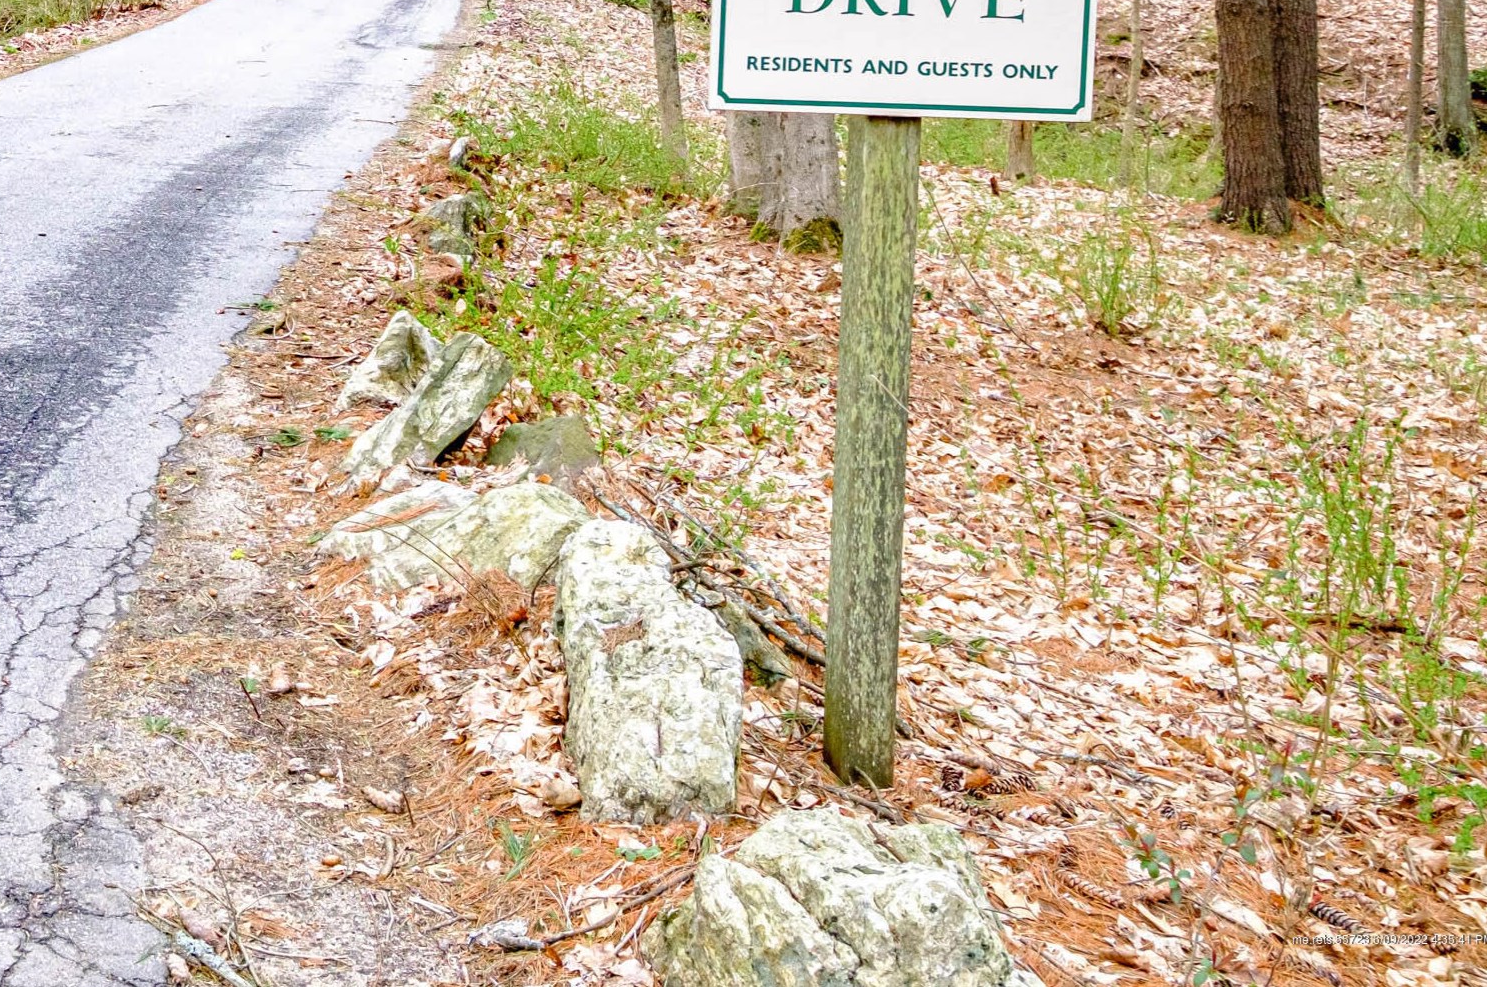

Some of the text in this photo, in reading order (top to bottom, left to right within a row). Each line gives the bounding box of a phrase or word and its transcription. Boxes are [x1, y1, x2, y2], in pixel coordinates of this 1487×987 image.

[747, 56, 1058, 79] RESIDENTS AND GUESTS ONLY
